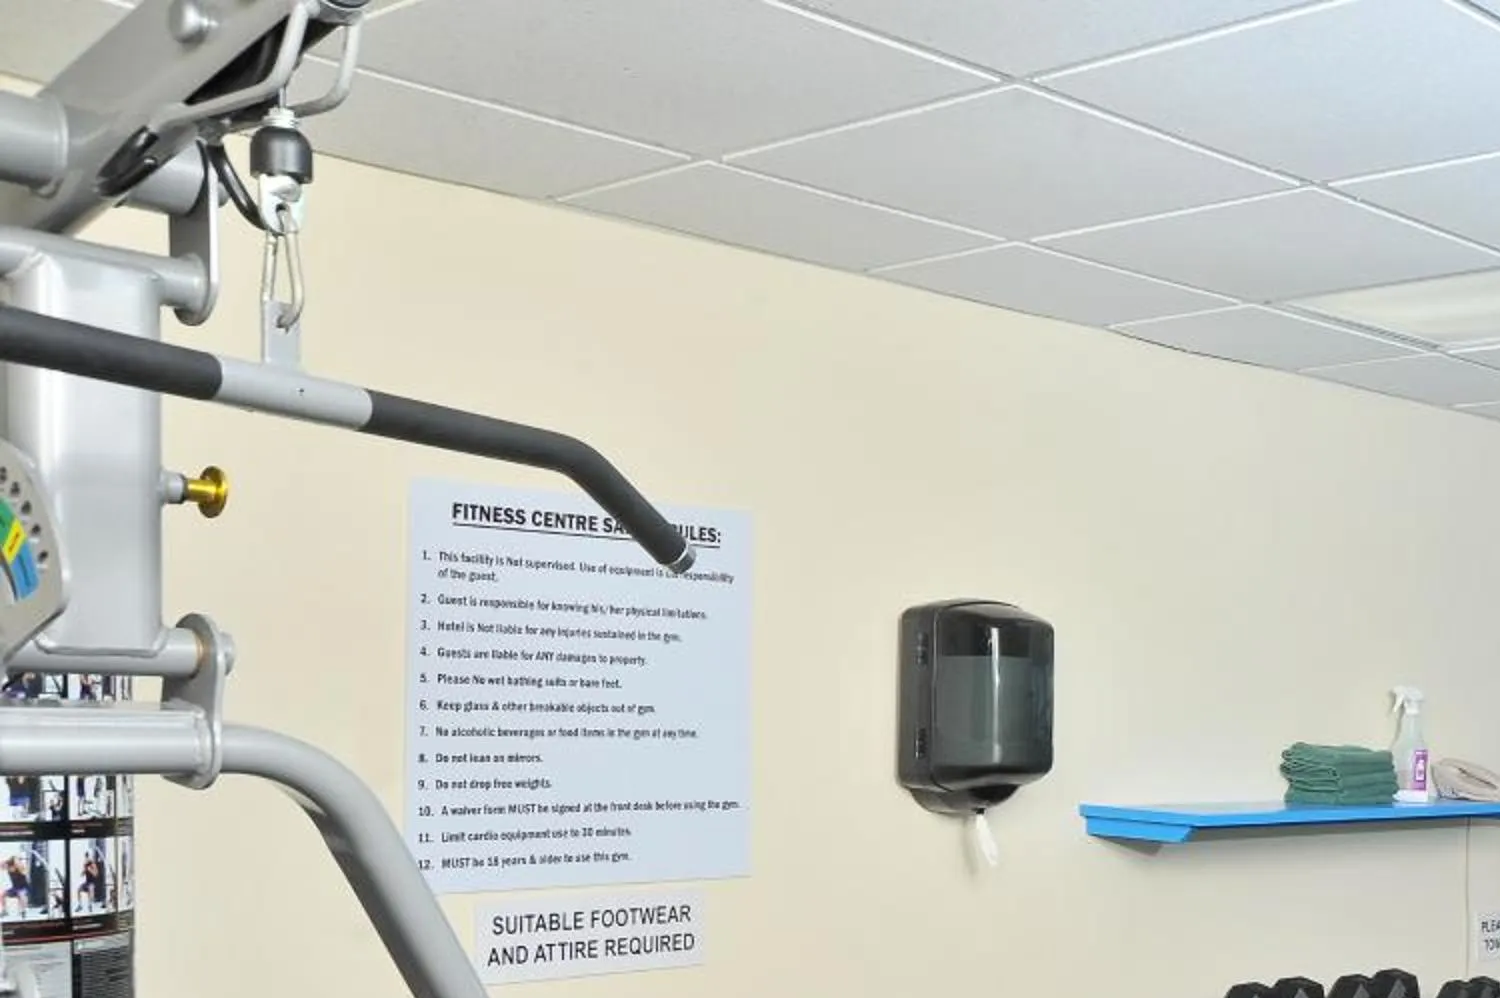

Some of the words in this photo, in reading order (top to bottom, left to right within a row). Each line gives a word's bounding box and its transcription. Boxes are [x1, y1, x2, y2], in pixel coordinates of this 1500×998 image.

[453, 502, 526, 524] FITNESS
[532, 510, 598, 532] CENTRE
[423, 550, 431, 560] 1.
[439, 551, 458, 562] This
[461, 552, 493, 567] facility
[496, 556, 504, 565] is
[507, 556, 523, 566] Not
[580, 562, 596, 572] Use
[599, 562, 606, 573] of
[609, 565, 654, 577] equipment
[656, 568, 663, 577] is
[438, 569, 448, 579] of
[450, 569, 465, 580] the
[468, 571, 499, 582] guest.
[420, 593, 431, 604] 2.
[437, 594, 467, 605] Guest
[470, 596, 477, 606] is
[479, 598, 535, 611] responsible
[537, 600, 549, 610] for
[551, 601, 589, 615] knowing
[625, 606, 661, 618] physical
[420, 620, 430, 631] 3.
[437, 621, 464, 632] Hotel
[466, 622, 475, 632] is
[477, 623, 494, 633] Not
[496, 623, 522, 634] liable
[525, 625, 538, 635] for
[539, 628, 556, 638] any
[558, 627, 592, 639] injuries
[593, 630, 636, 641] sustained
[638, 631, 646, 641] in
[647, 631, 661, 641] the
[420, 646, 430, 657] 4.
[437, 647, 471, 659] Guests
[474, 650, 488, 659] are
[492, 649, 518, 660] liable
[520, 650, 533, 660] for
[535, 651, 554, 661] ANY
[556, 652, 597, 664] damages
[599, 654, 608, 663] to
[420, 673, 429, 683] 5.
[437, 673, 469, 684] Please
[472, 674, 485, 685] No
[487, 675, 504, 685] wet
[507, 675, 543, 688] bathing
[570, 679, 578, 687] or
[580, 677, 600, 688] bare
[602, 678, 623, 689] feet.
[420, 700, 429, 711] 6.
[437, 700, 462, 712] Keep
[464, 701, 489, 713] glass
[491, 701, 499, 711] &
[502, 701, 527, 711] other
[529, 702, 574, 713] breakable
[576, 704, 609, 715] objects
[611, 704, 625, 713] out
[627, 704, 636, 713] of
[420, 726, 429, 737] 7.
[435, 726, 448, 737] No
[451, 726, 497, 737] alcoholic
[498, 728, 545, 739] beverages
[547, 729, 556, 737] or
[558, 728, 578, 737] food
[581, 728, 604, 737] items
[606, 728, 614, 737] in
[618, 728, 631, 737] the
[633, 729, 650, 740] gym
[652, 728, 660, 739] at
[418, 753, 428, 763] 8.
[435, 753, 449, 763] Do
[452, 753, 467, 763] not
[470, 753, 490, 763] lean
[493, 754, 504, 763] on
[507, 752, 543, 763] mirrors.
[418, 779, 428, 790] 9.
[435, 779, 448, 789] Do
[452, 779, 467, 789] not
[470, 778, 490, 790] drop
[494, 779, 512, 789] free
[419, 805, 434, 817] 10.
[441, 805, 449, 816] A
[451, 805, 481, 815] waiver
[484, 803, 506, 815] form
[508, 803, 536, 814] MUST
[538, 804, 548, 814] be
[551, 803, 581, 815] signed
[584, 803, 592, 812] at
[594, 803, 608, 812] the
[610, 801, 631, 812] front
[633, 801, 653, 811] desk
[655, 801, 682, 811] before
[684, 800, 706, 811] using
[707, 800, 720, 809] the
[418, 833, 434, 843] 11.
[442, 831, 465, 843] Limit
[467, 830, 499, 842] cardio
[501, 829, 550, 841] equipment
[552, 829, 568, 839] use
[570, 829, 580, 838] to
[418, 859, 435, 870] 12.
[442, 857, 470, 869] MUST
[472, 857, 484, 867] be
[501, 856, 527, 868] years
[528, 854, 537, 865] &
[539, 854, 563, 865] older
[564, 854, 574, 863] to
[575, 853, 591, 863] use
[593, 852, 609, 862] this
[611, 852, 631, 863] gym.
[492, 911, 585, 935] SUITABLE
[590, 904, 692, 928] FOOTWEAR
[487, 945, 529, 967] AND
[534, 940, 599, 963] ATTIRE
[604, 933, 695, 956] REQUIRED
